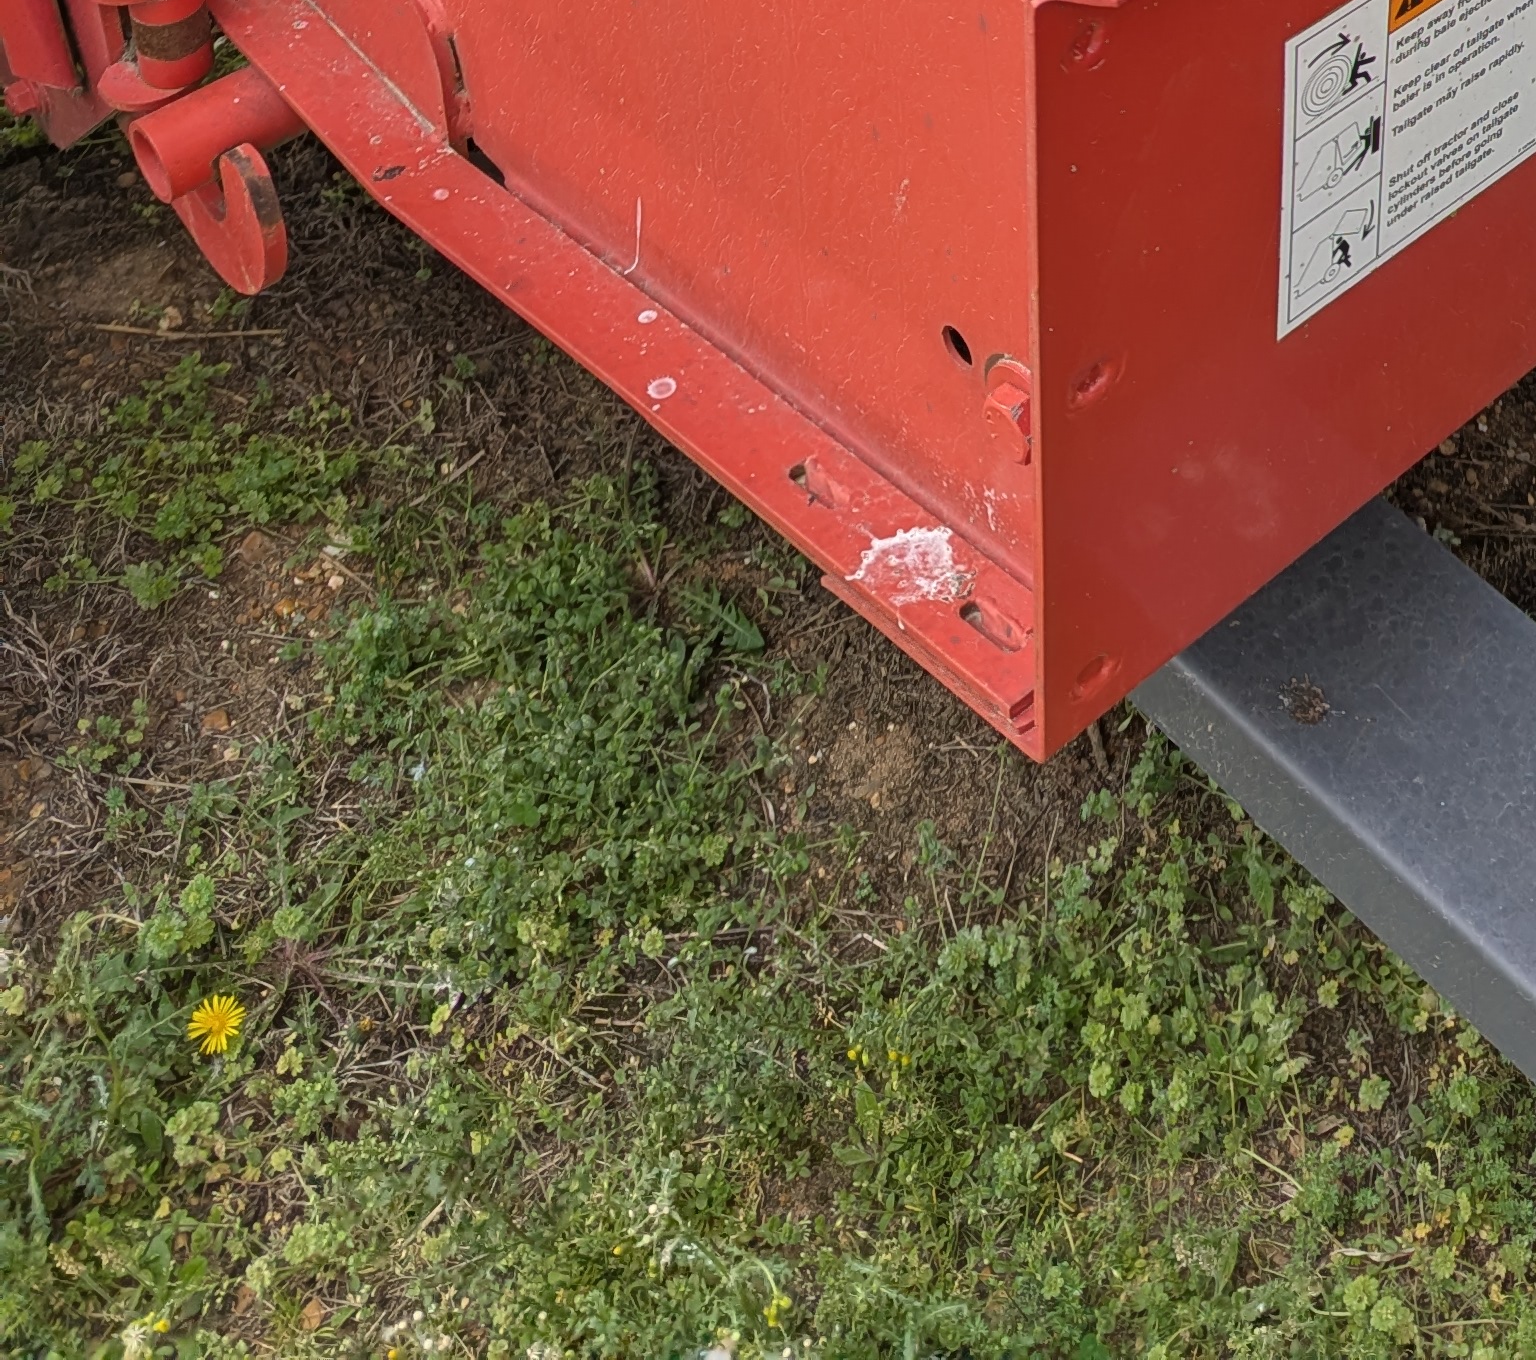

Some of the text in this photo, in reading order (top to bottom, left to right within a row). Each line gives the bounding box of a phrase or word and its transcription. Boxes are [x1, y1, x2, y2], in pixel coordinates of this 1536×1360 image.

[1393, 73, 1422, 98] Keep
[1424, 53, 1452, 77] clear
[1453, 41, 1465, 57] of
[1466, 17, 1505, 48] tailgate
[1395, 35, 1431, 64] during
[1434, 18, 1457, 38] bale
[1396, 26, 1425, 50] Keep
[1427, 5, 1456, 29] away
[1391, 40, 1525, 136] Tailgate may raise rapidly.
[1393, 35, 1501, 112] baler is in operation.
[1387, 174, 1436, 214] cylinders
[1439, 149, 1472, 178] before
[1474, 126, 1504, 154] going
[1388, 103, 1519, 201] lockout valves on tailgate
[1389, 91, 1520, 187] Shut off tractor and close
[1387, 147, 1495, 227] under raised tailgate.
